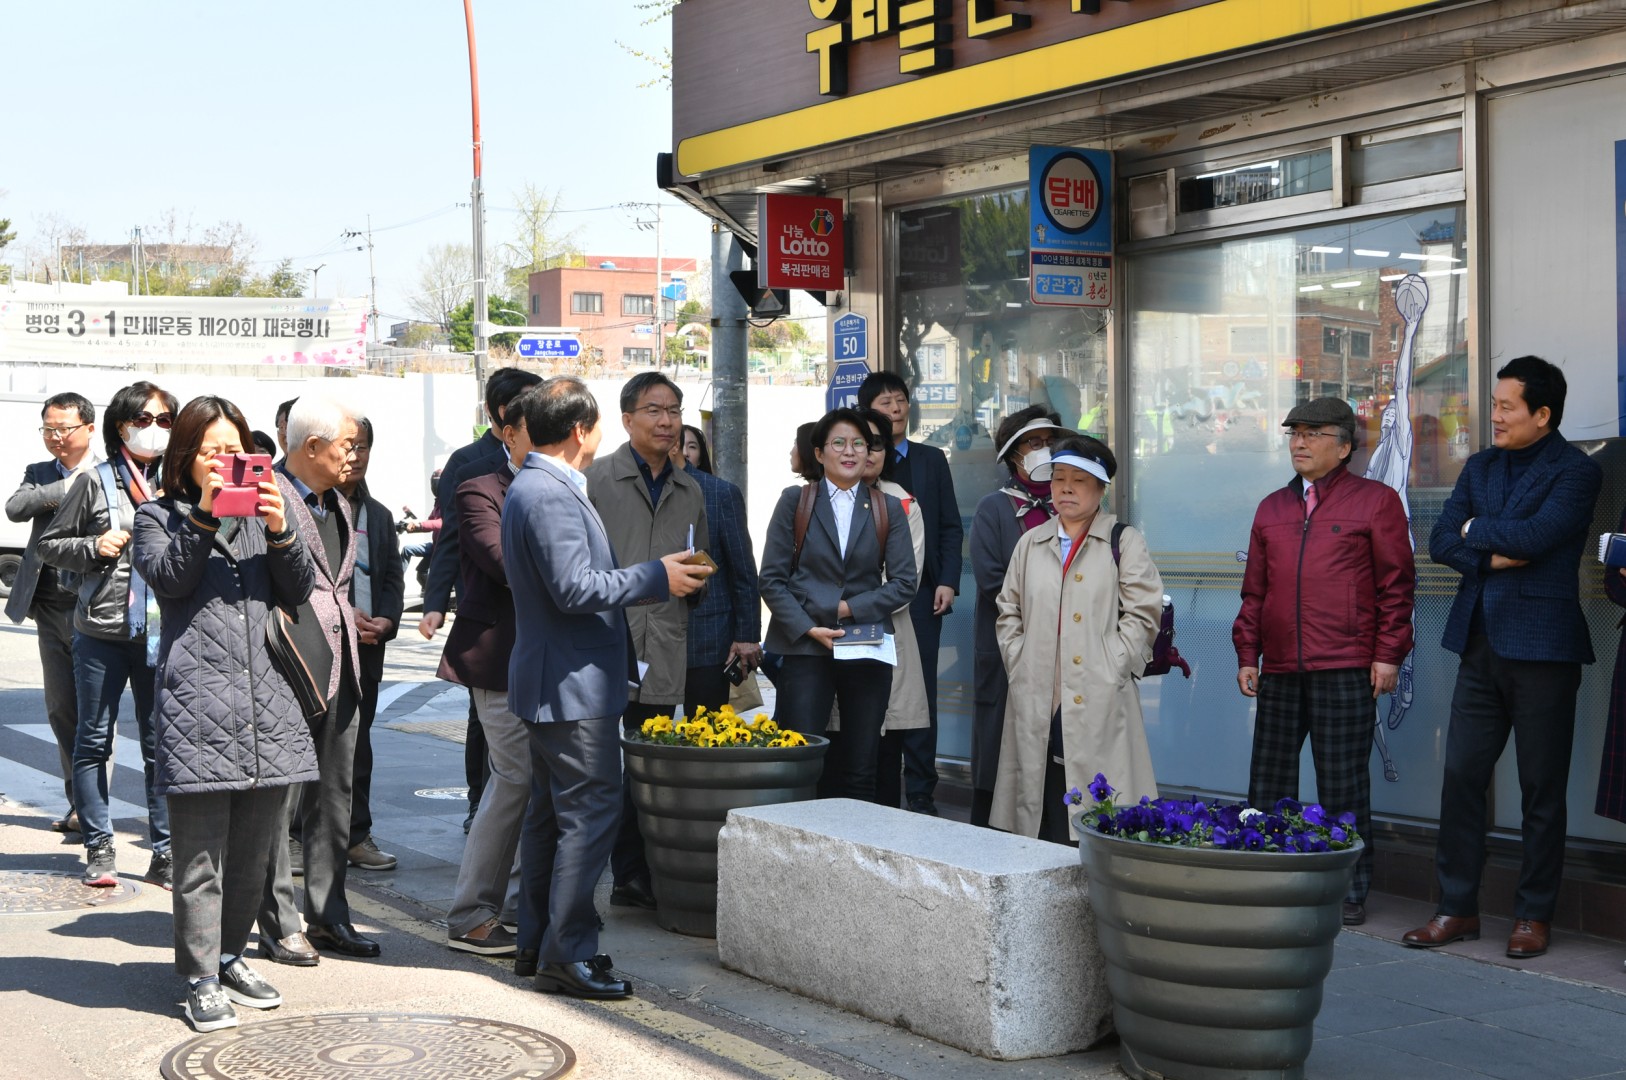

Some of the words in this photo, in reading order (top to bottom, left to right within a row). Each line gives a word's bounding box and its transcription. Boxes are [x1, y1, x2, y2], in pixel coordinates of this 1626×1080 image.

[1048, 176, 1095, 210] 담배
[1053, 208, 1090, 217] CIGARETTES
[783, 224, 804, 239] 나눔
[780, 235, 830, 257] Lotto
[1041, 254, 1058, 264] 100년
[1060, 255, 1075, 265] 전통의
[780, 262, 830, 278] 복권판매점
[1088, 271, 1107, 281] 6년근
[1037, 276, 1082, 295] 정관장
[1086, 281, 1108, 300] 홍삼
[25, 314, 60, 334] 병영
[123, 315, 192, 337] 만세운동
[199, 317, 257, 338] 제20회
[262, 317, 331, 339] 재현행사
[537, 340, 561, 349] 장춘로
[842, 336, 858, 356] 50
